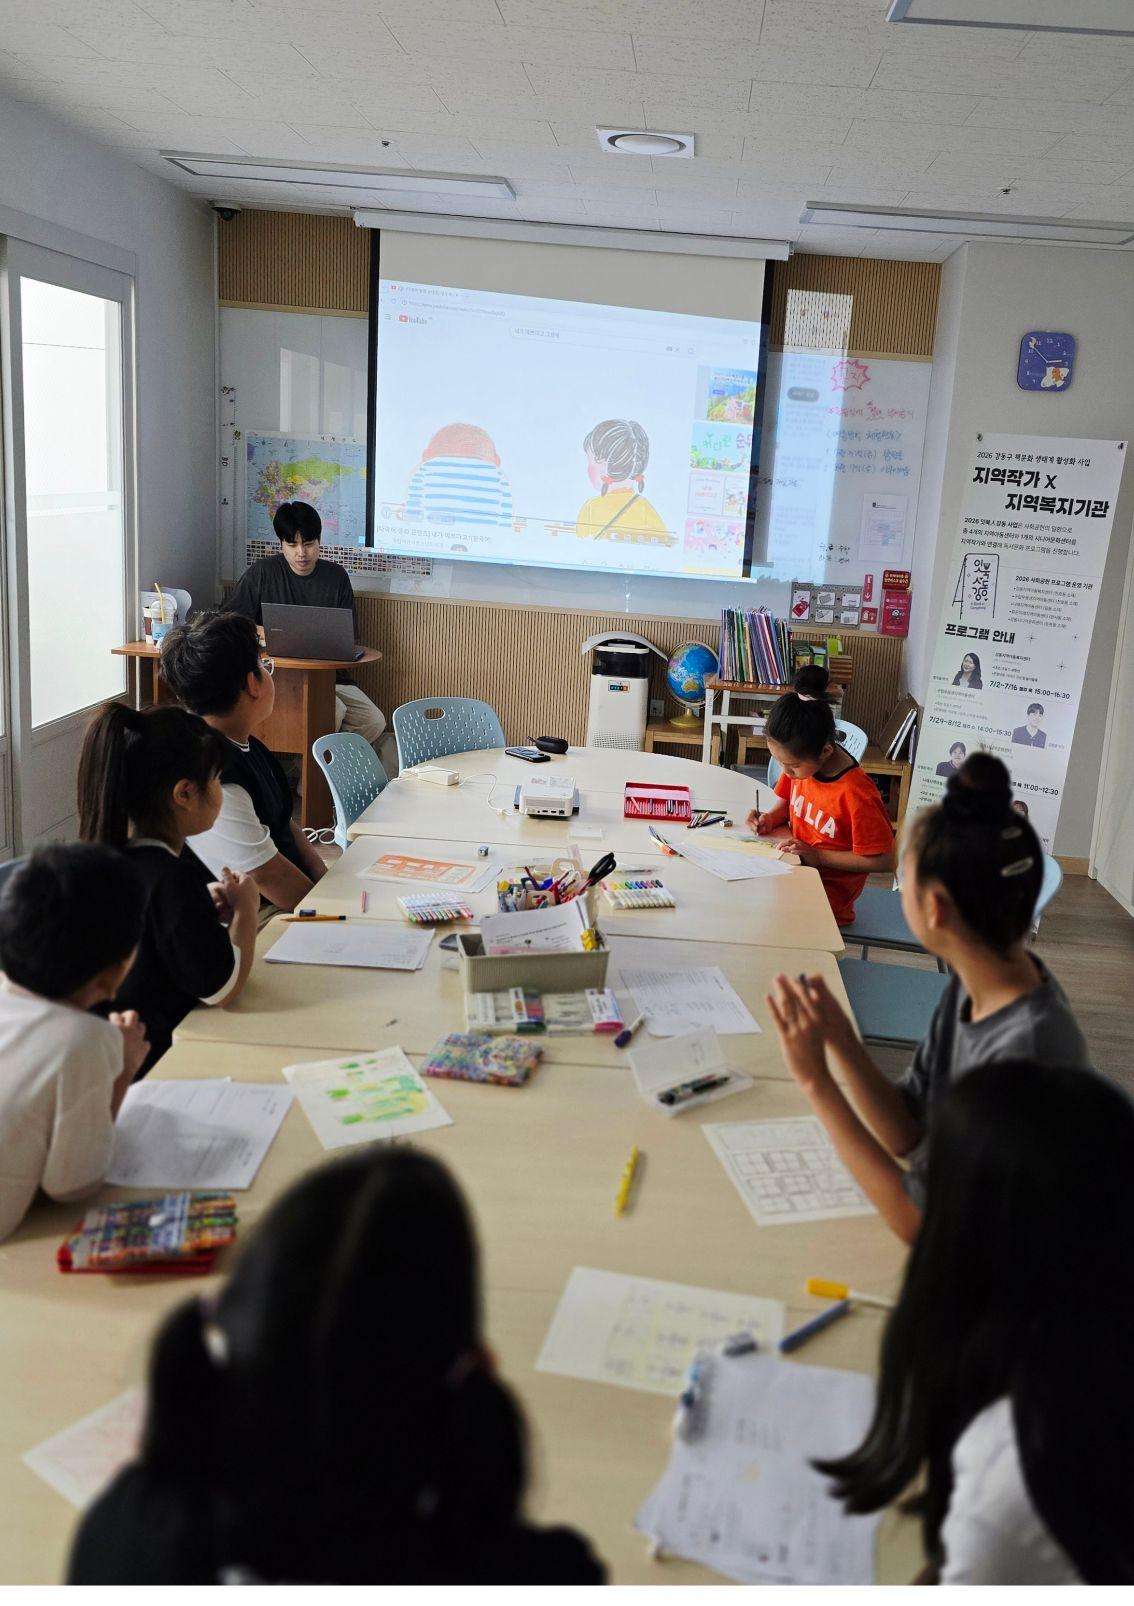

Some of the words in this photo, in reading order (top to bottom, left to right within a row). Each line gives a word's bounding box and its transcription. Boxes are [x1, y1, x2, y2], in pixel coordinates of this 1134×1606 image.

[976, 451, 993, 459] 2026
[995, 452, 1013, 461] 강동구
[1015, 453, 1034, 463] 책문화
[1035, 455, 1055, 464] 생태계
[1056, 456, 1076, 466] 활성화
[1078, 458, 1091, 467] 사업
[972, 466, 1041, 488] 지역작가
[1044, 474, 1058, 489] X
[1005, 493, 1110, 518] 지역복지기관
[964, 517, 980, 525] 2026
[945, 623, 990, 641] 프로그램
[992, 631, 1016, 644] 안내
